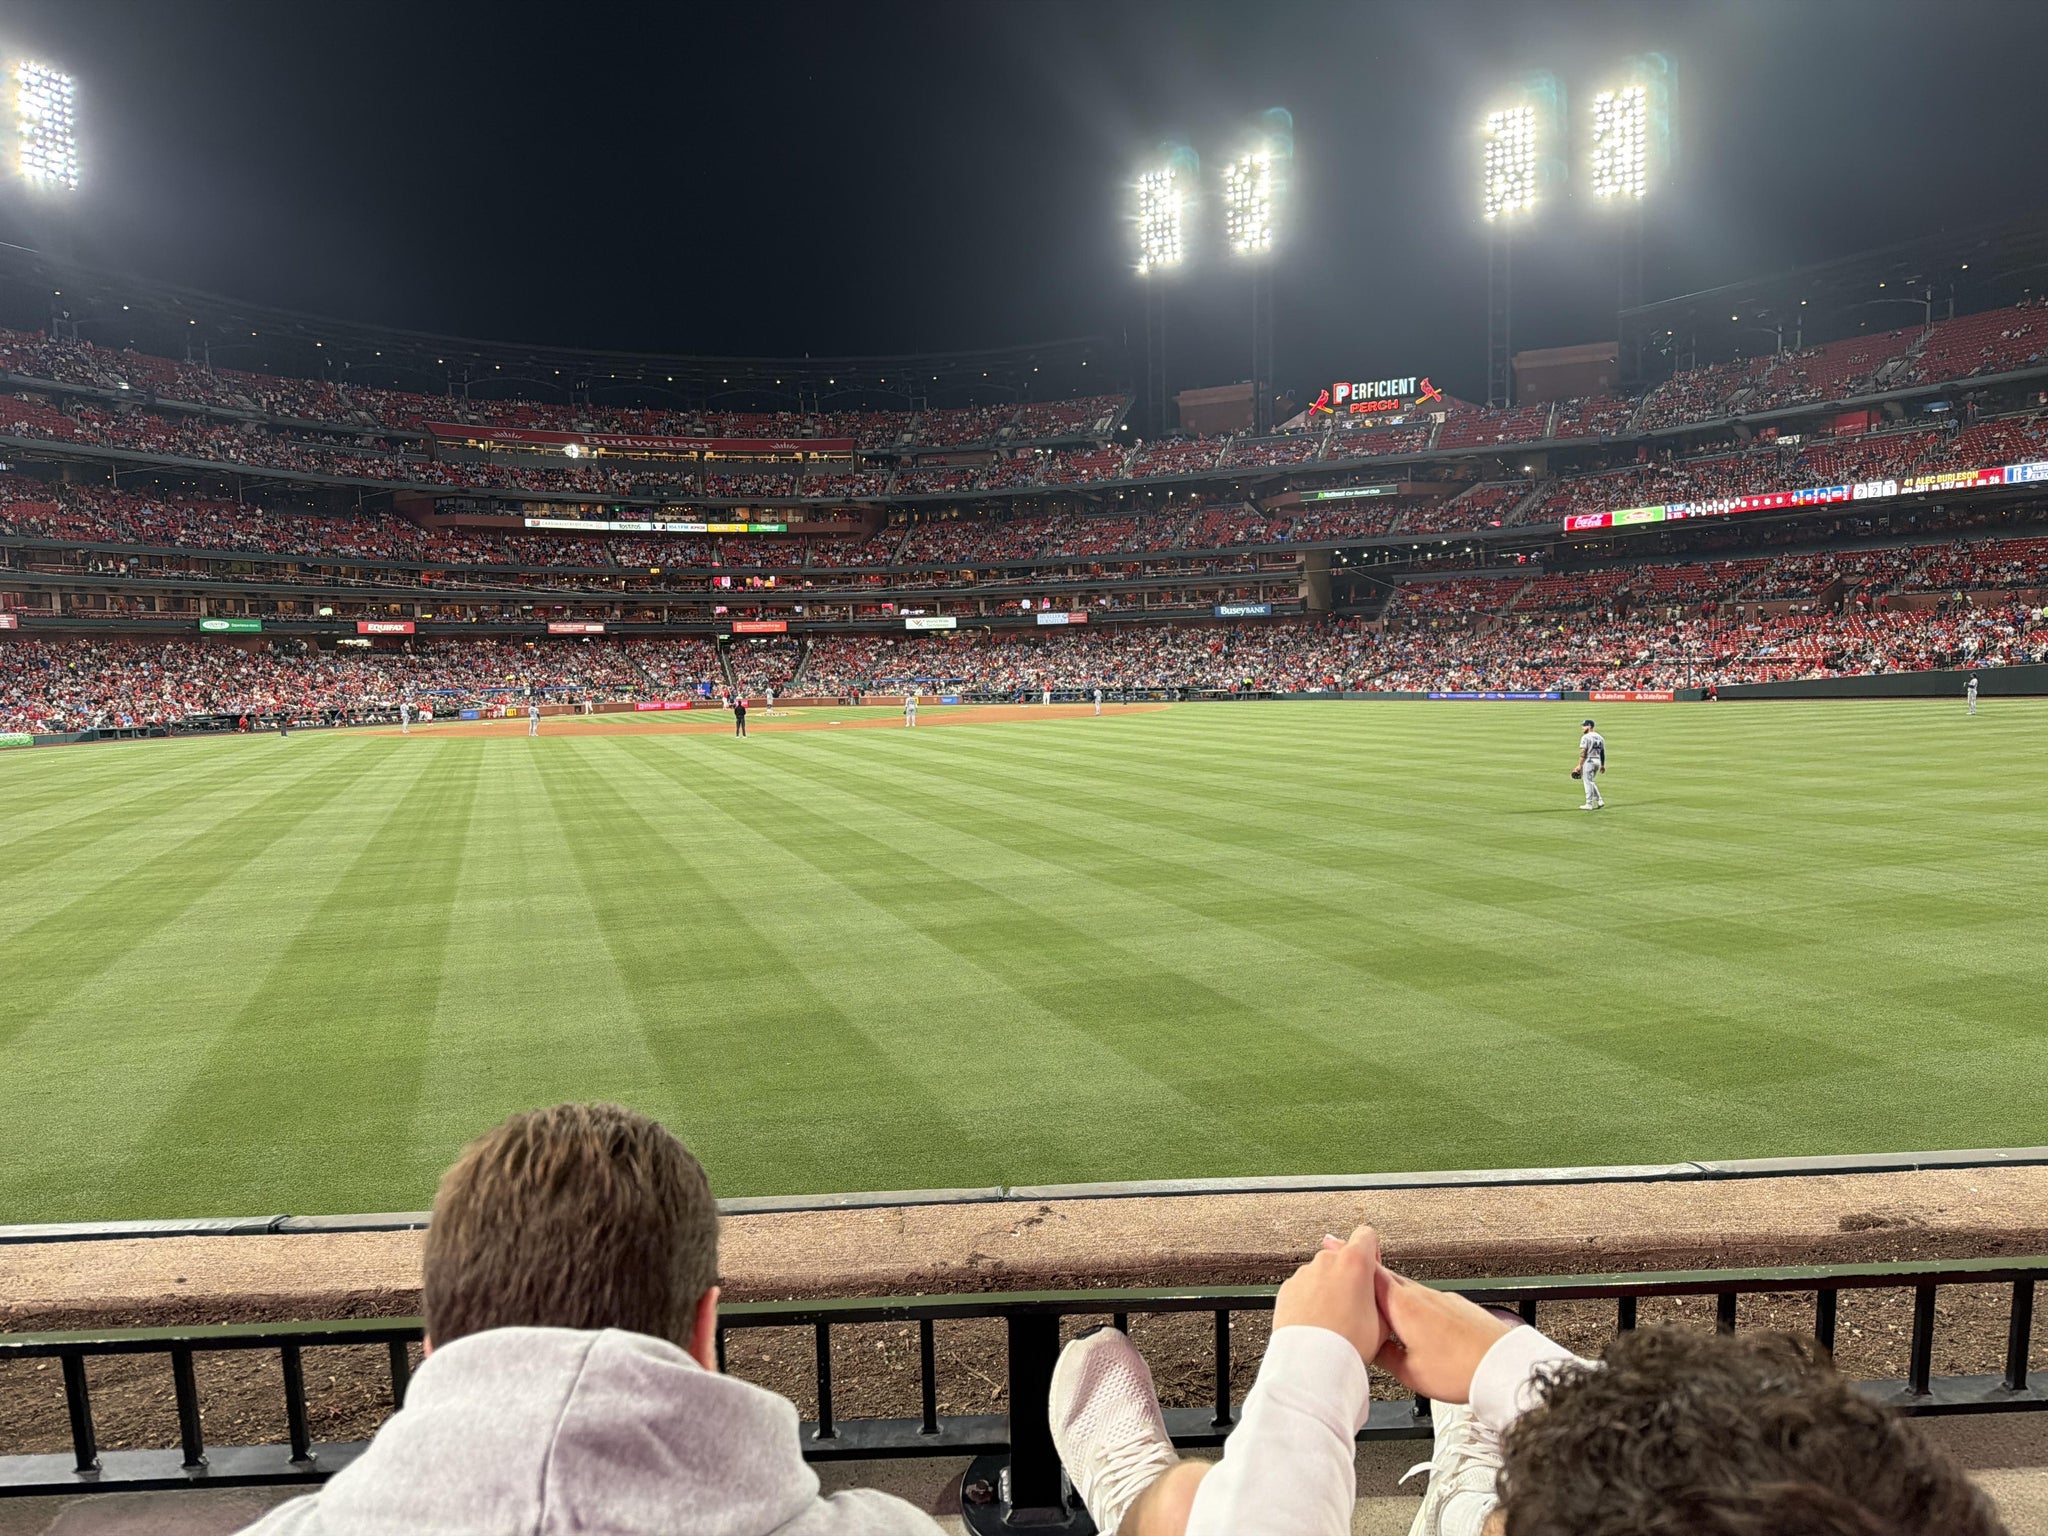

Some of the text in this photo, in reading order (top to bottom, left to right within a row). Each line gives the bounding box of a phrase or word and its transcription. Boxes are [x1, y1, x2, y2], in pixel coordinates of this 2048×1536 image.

[1333, 377, 1416, 404] PERFICIENT
[1349, 399, 1400, 414] PERCH
[582, 435, 713, 450] Budweiser
[1904, 478, 1914, 487] 41
[1916, 475, 1936, 485] ALEC
[1937, 470, 1979, 482] BURLESON
[1941, 482, 1954, 490] 137
[1989, 476, 2000, 484] 26
[1857, 485, 1894, 498] 2 2 1
[368, 624, 404, 632] EQUIFAX
